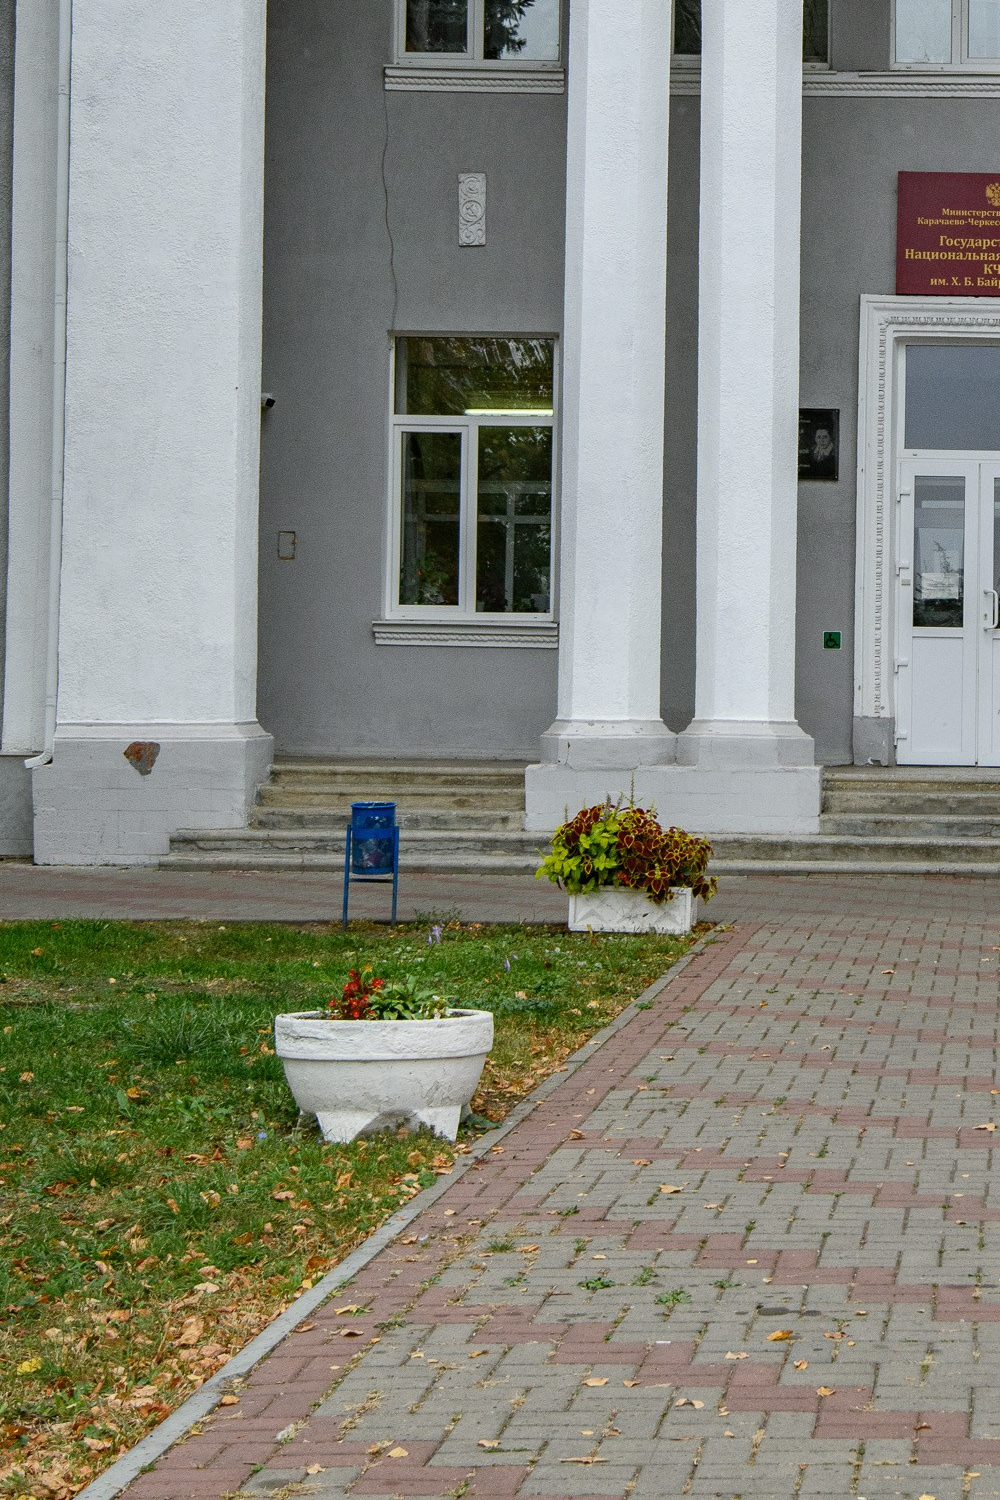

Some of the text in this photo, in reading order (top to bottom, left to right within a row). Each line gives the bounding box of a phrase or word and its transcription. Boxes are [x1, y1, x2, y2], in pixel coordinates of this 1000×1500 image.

[930, 278, 949, 286] им.
[951, 277, 961, 286] Х.
[964, 277, 974, 286] Б.
